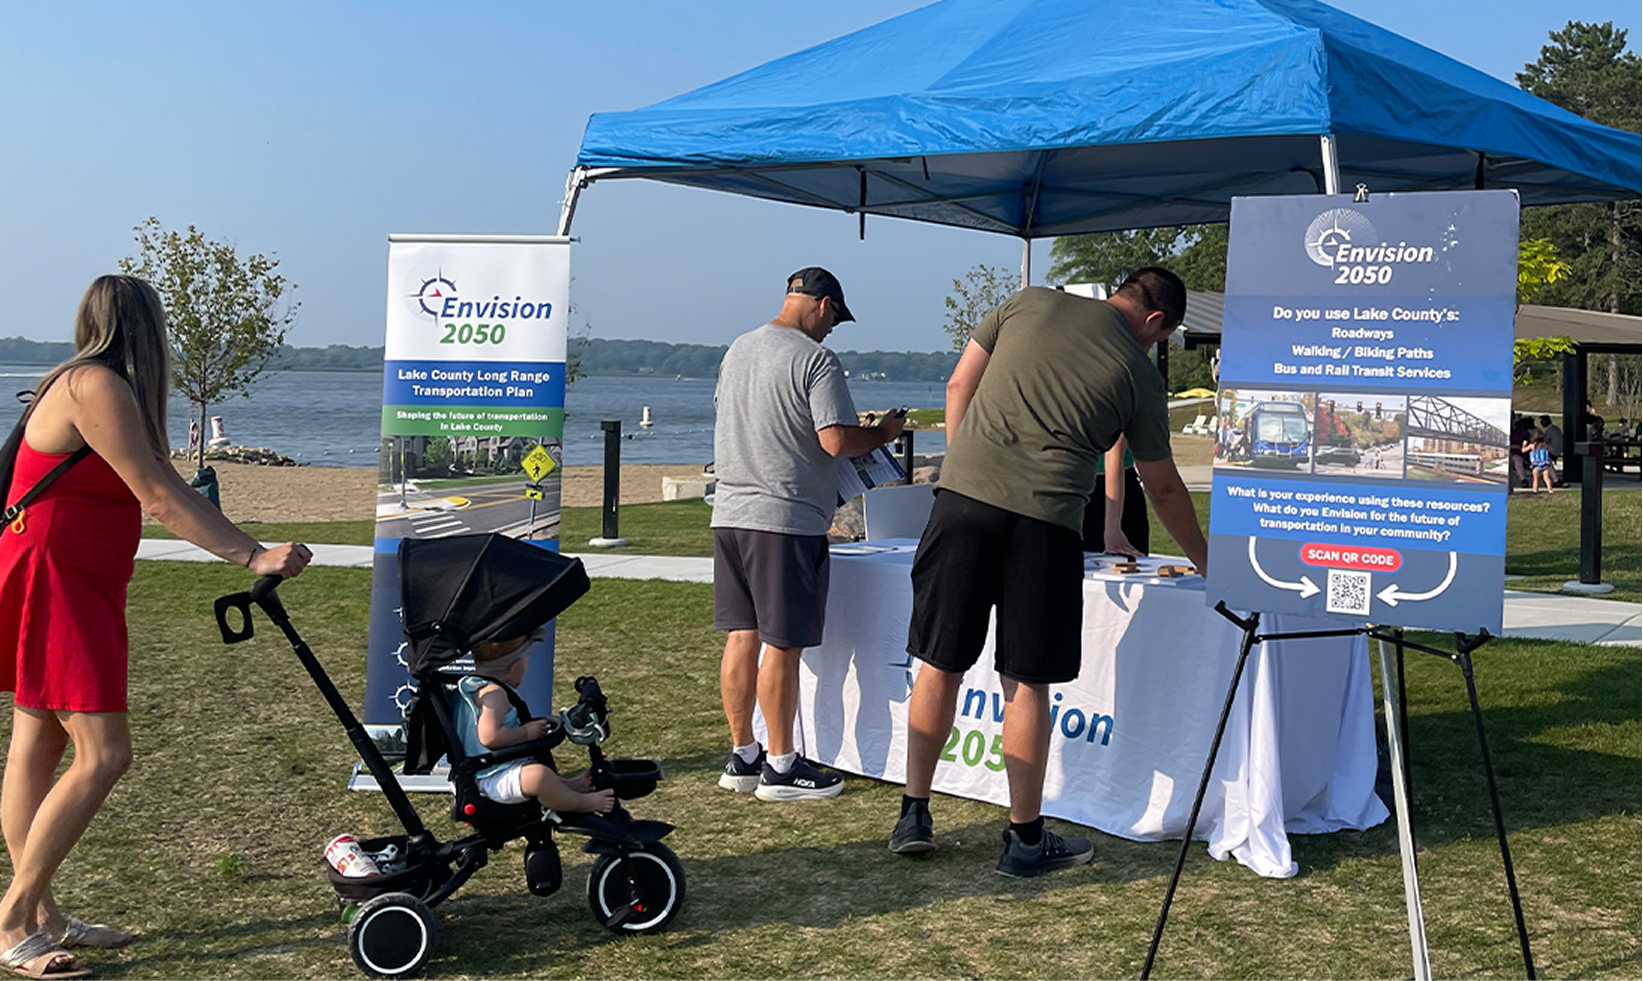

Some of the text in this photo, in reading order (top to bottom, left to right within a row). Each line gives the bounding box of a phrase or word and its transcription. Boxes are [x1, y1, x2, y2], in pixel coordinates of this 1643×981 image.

[1335, 241, 1433, 263] Envision
[1334, 265, 1393, 285] 2050
[440, 296, 552, 319] Envision
[1273, 306, 1460, 324] Do you use Lake County's:
[440, 323, 506, 344] 2050
[1332, 327, 1394, 341] Roadways
[1292, 345, 1434, 360] Walking / Biking Paths
[398, 369, 550, 383] Lake County Long Range
[1274, 362, 1451, 379] Bus and Rail Transit Services
[412, 385, 533, 398] Transportation Plan
[396, 411, 548, 421] Shaping the future of transportation
[450, 423, 471, 431] Lake
[473, 423, 503, 432] County
[1227, 486, 1490, 513] What is your experience using these resources?
[1253, 502, 1460, 526] What do you Envision for the future of
[1259, 517, 1337, 533] transportation
[1353, 525, 1378, 536] your
[1380, 527, 1451, 542] community?
[1308, 549, 1394, 566] SCAN QR CODE
[961, 688, 1114, 746] nvion
[940, 726, 1007, 772] 205
